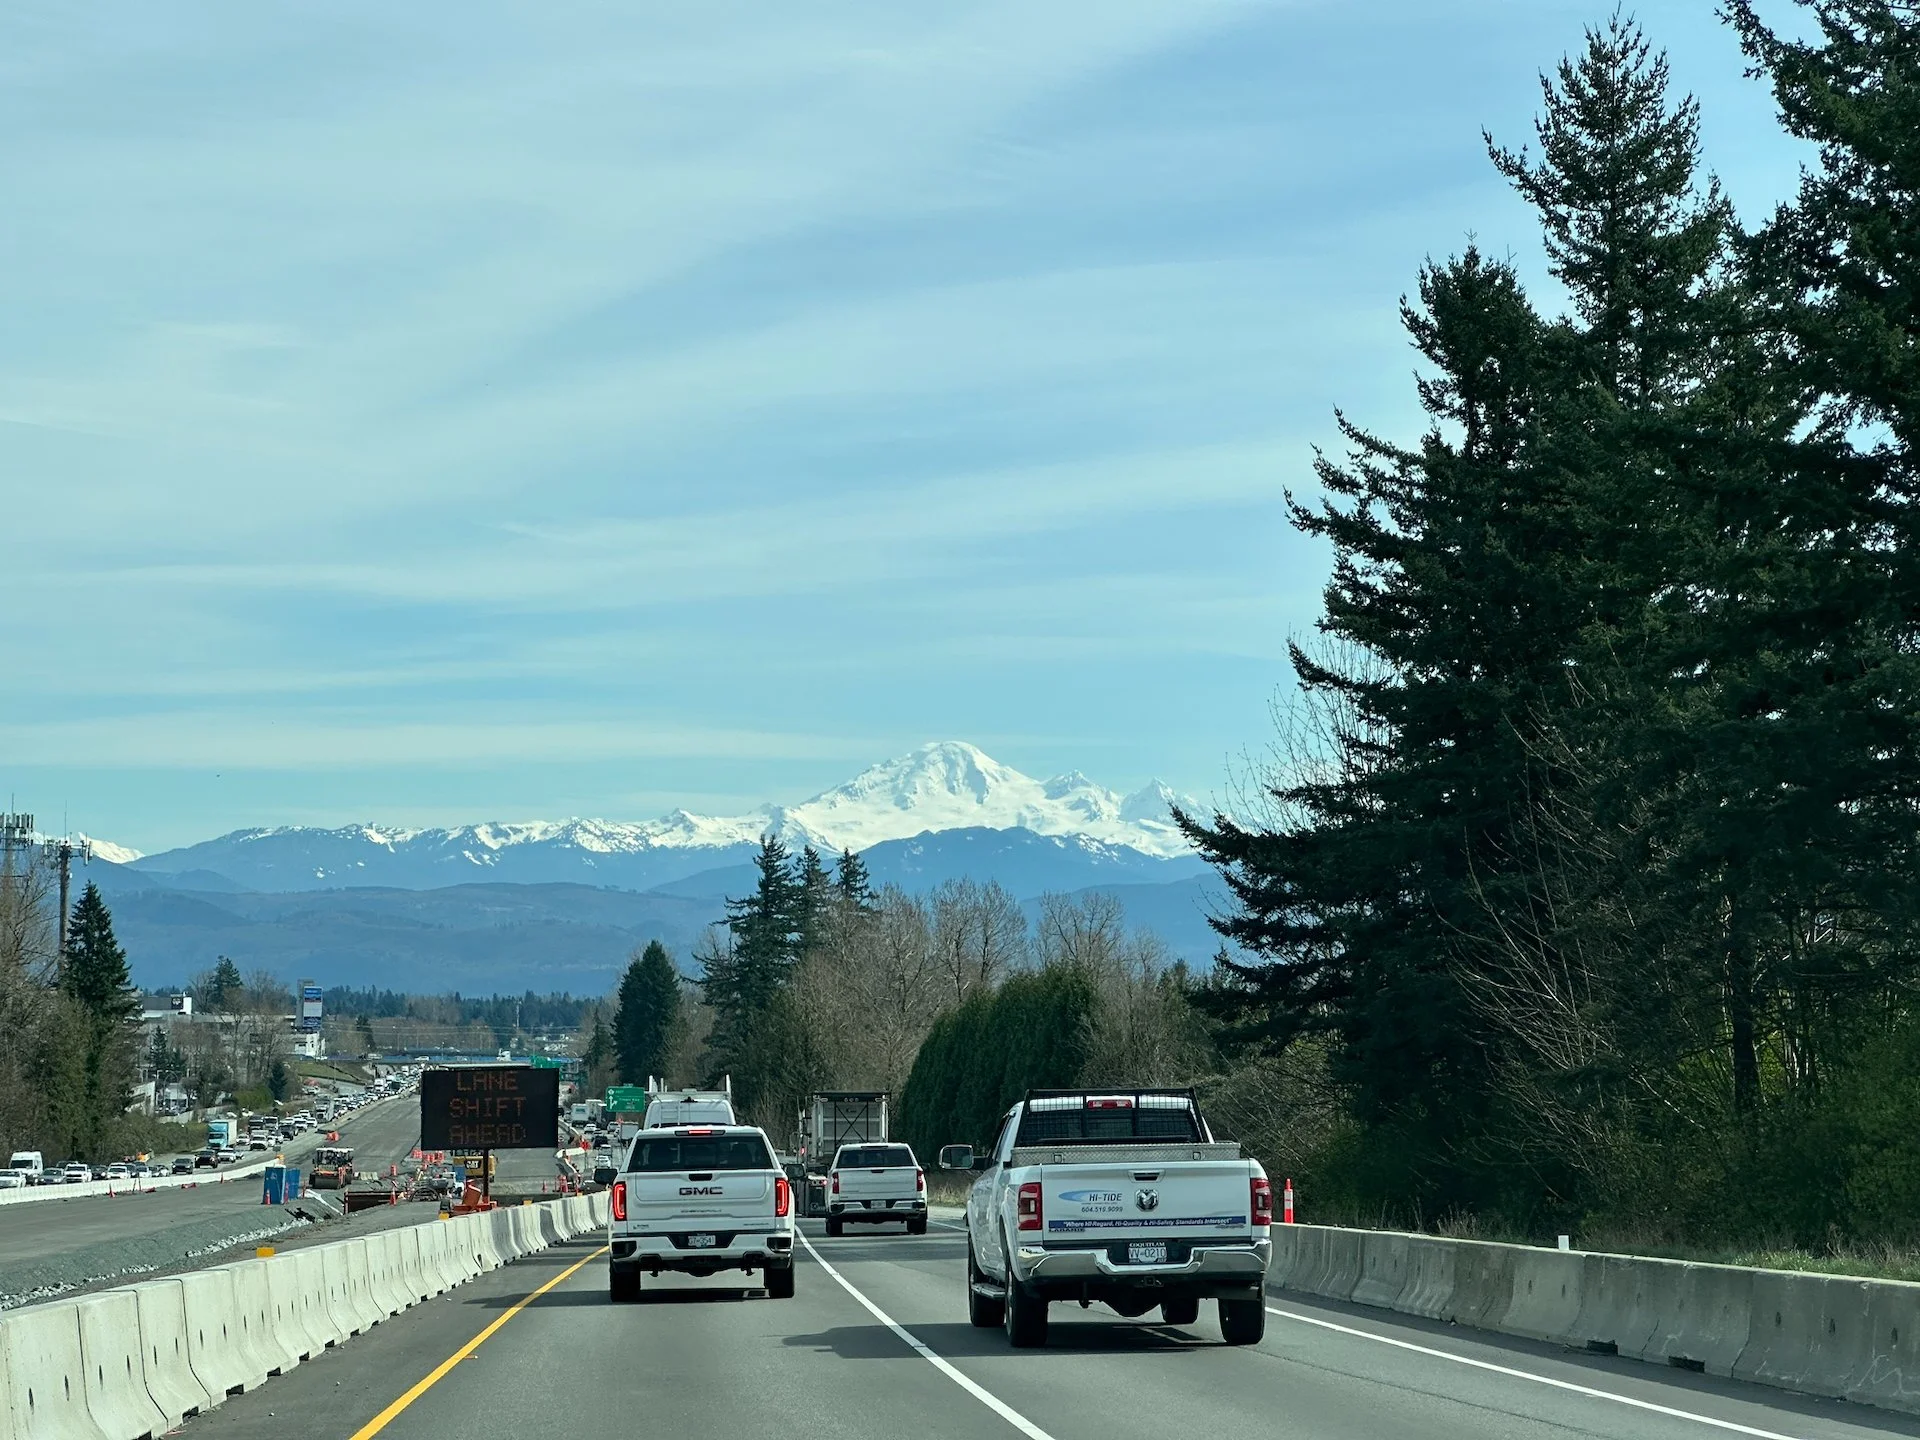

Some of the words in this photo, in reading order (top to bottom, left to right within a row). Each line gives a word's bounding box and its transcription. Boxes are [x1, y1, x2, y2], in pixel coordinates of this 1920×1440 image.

[457, 1070, 518, 1091] LANE
[449, 1097, 526, 1118] SHIFT
[449, 1124, 526, 1144] AHEAD
[679, 1187, 723, 1196] GMC
[1089, 1193, 1123, 1202] HI-TIDE
